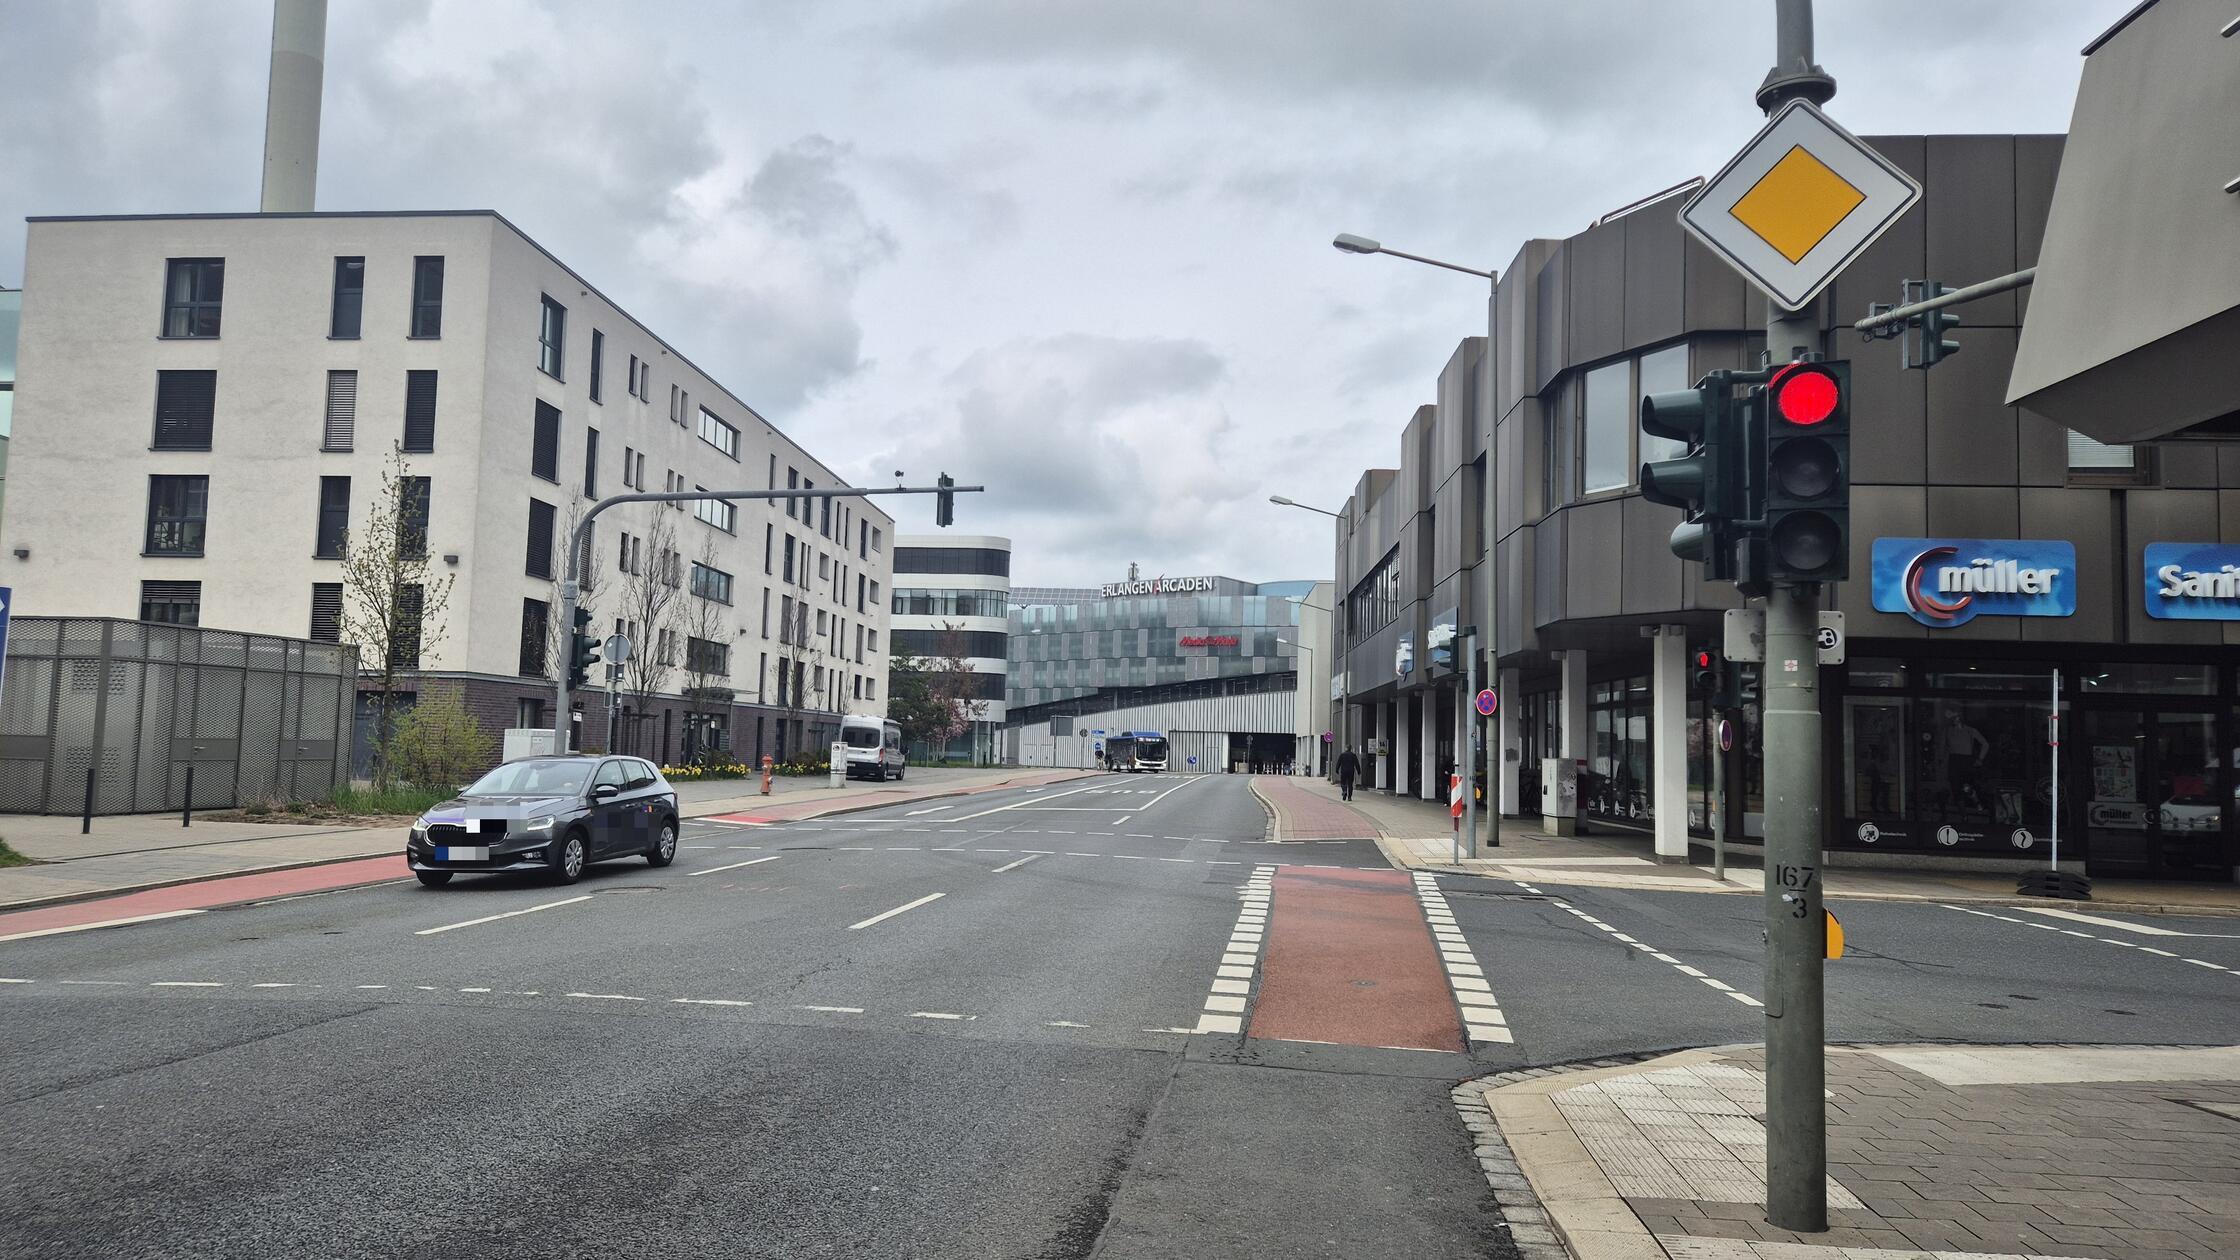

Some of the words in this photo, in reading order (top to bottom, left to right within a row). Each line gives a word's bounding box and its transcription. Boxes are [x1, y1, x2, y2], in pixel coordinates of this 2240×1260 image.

[1101, 581, 1153, 598] ERLANGEN
[1154, 576, 1213, 595] ARCADEN
[1938, 558, 2060, 595] müller
[2100, 808, 2133, 820] müller
[1776, 864, 1815, 889] 167
[1792, 897, 1808, 919] 3
